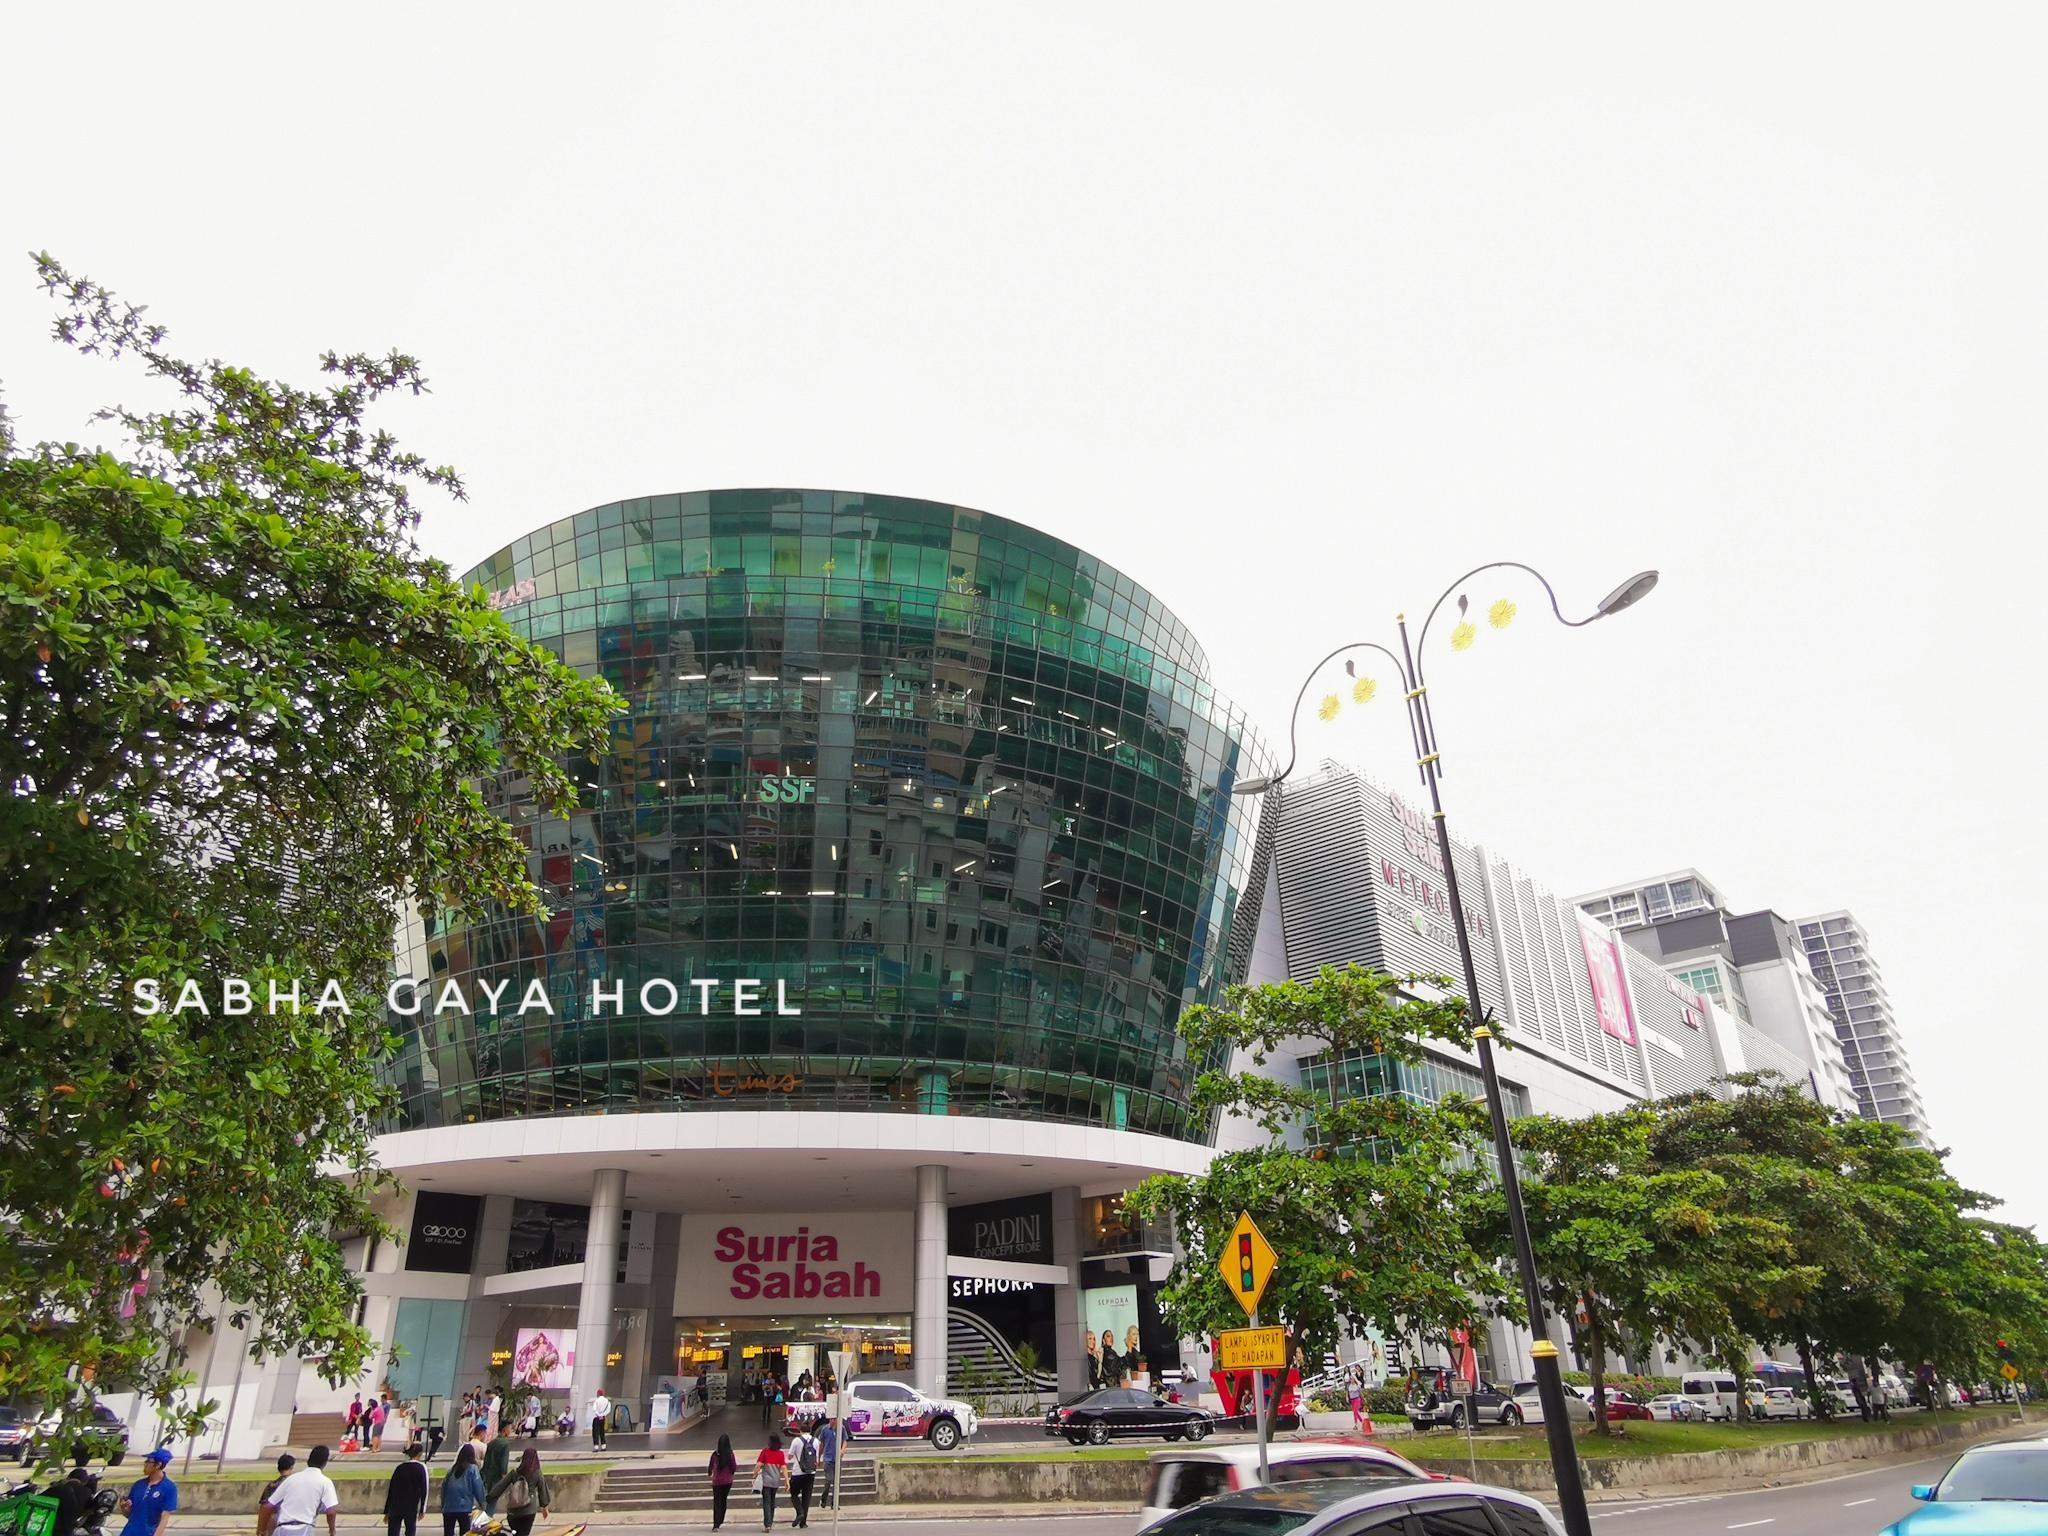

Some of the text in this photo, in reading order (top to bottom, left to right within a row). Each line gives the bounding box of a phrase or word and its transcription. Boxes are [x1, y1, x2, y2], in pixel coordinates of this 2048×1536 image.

[1381, 857, 1486, 938] METROYA
[423, 1225, 466, 1239] G2000
[975, 1214, 1040, 1248] PADINI
[714, 1227, 838, 1262] Suria
[975, 1241, 1041, 1258] CONCEPT STORE
[730, 1262, 881, 1300] Sabah
[1097, 1297, 1129, 1306] SEPHORA
[1225, 1332, 1279, 1348] LAMPU ISYARAT
[1231, 1350, 1274, 1363] DI HADAPAN
